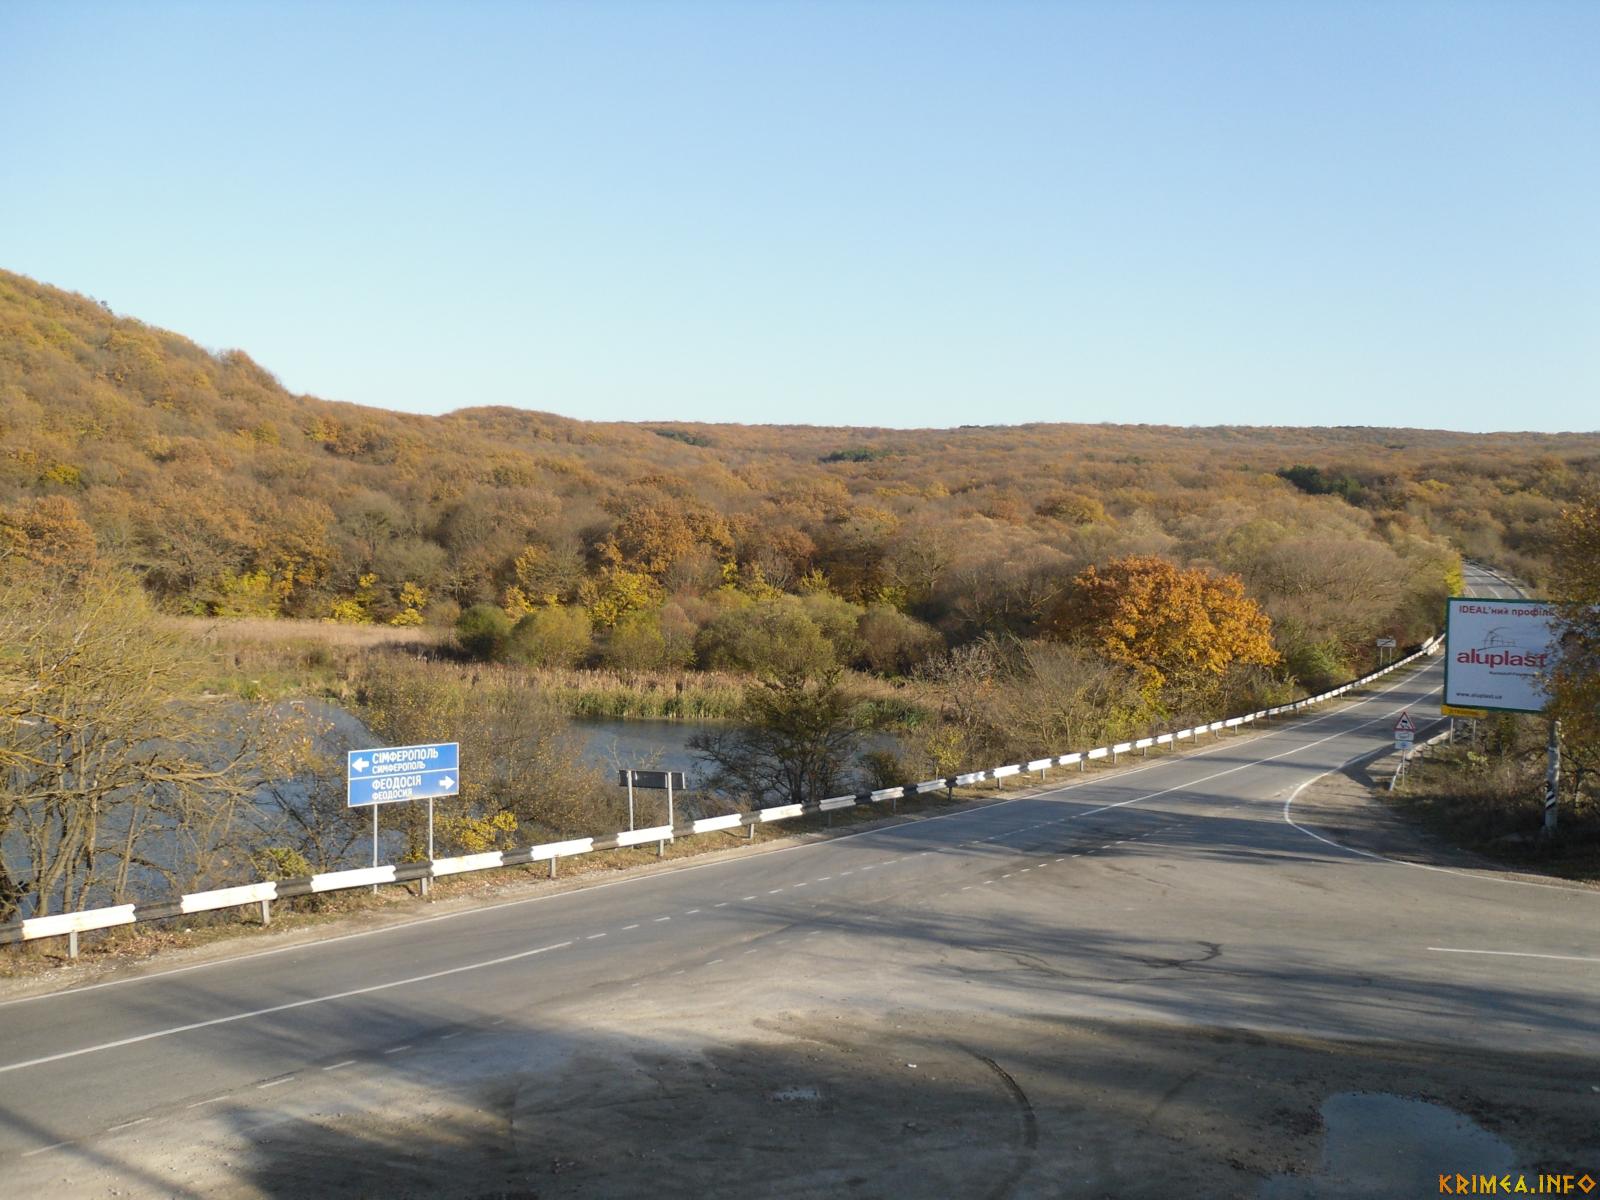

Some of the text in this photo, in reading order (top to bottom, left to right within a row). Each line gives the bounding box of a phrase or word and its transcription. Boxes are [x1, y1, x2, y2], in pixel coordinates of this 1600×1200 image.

[1457, 648, 1548, 669] aluplast
[372, 748, 439, 764] СІМФЕРОПОЛЬ
[372, 761, 426, 774] СИМФЕРОПОЛЬ
[372, 775, 422, 790] ФЕОДОСІЯ
[372, 789, 413, 801] ФЕОДОСИЯ
